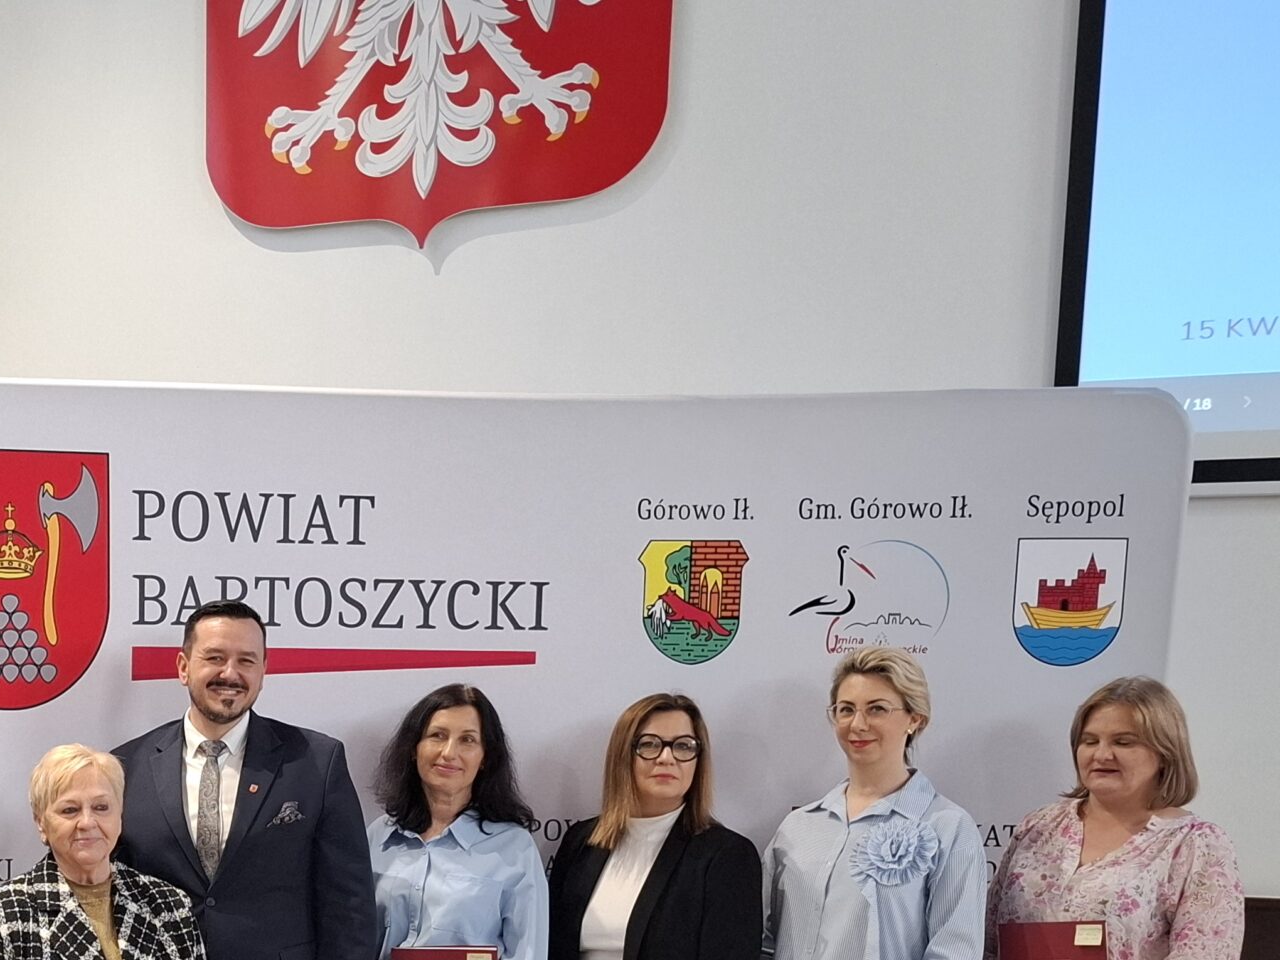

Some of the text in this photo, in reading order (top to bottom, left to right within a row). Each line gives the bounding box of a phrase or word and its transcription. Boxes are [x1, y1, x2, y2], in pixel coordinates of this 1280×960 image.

[1181, 319, 1215, 341] 15
[131, 489, 376, 546] POWIAT
[637, 497, 755, 521] Górowo Ił.
[798, 495, 974, 521] Gm. Górowo Ił.
[1026, 493, 1126, 524] Sępopol
